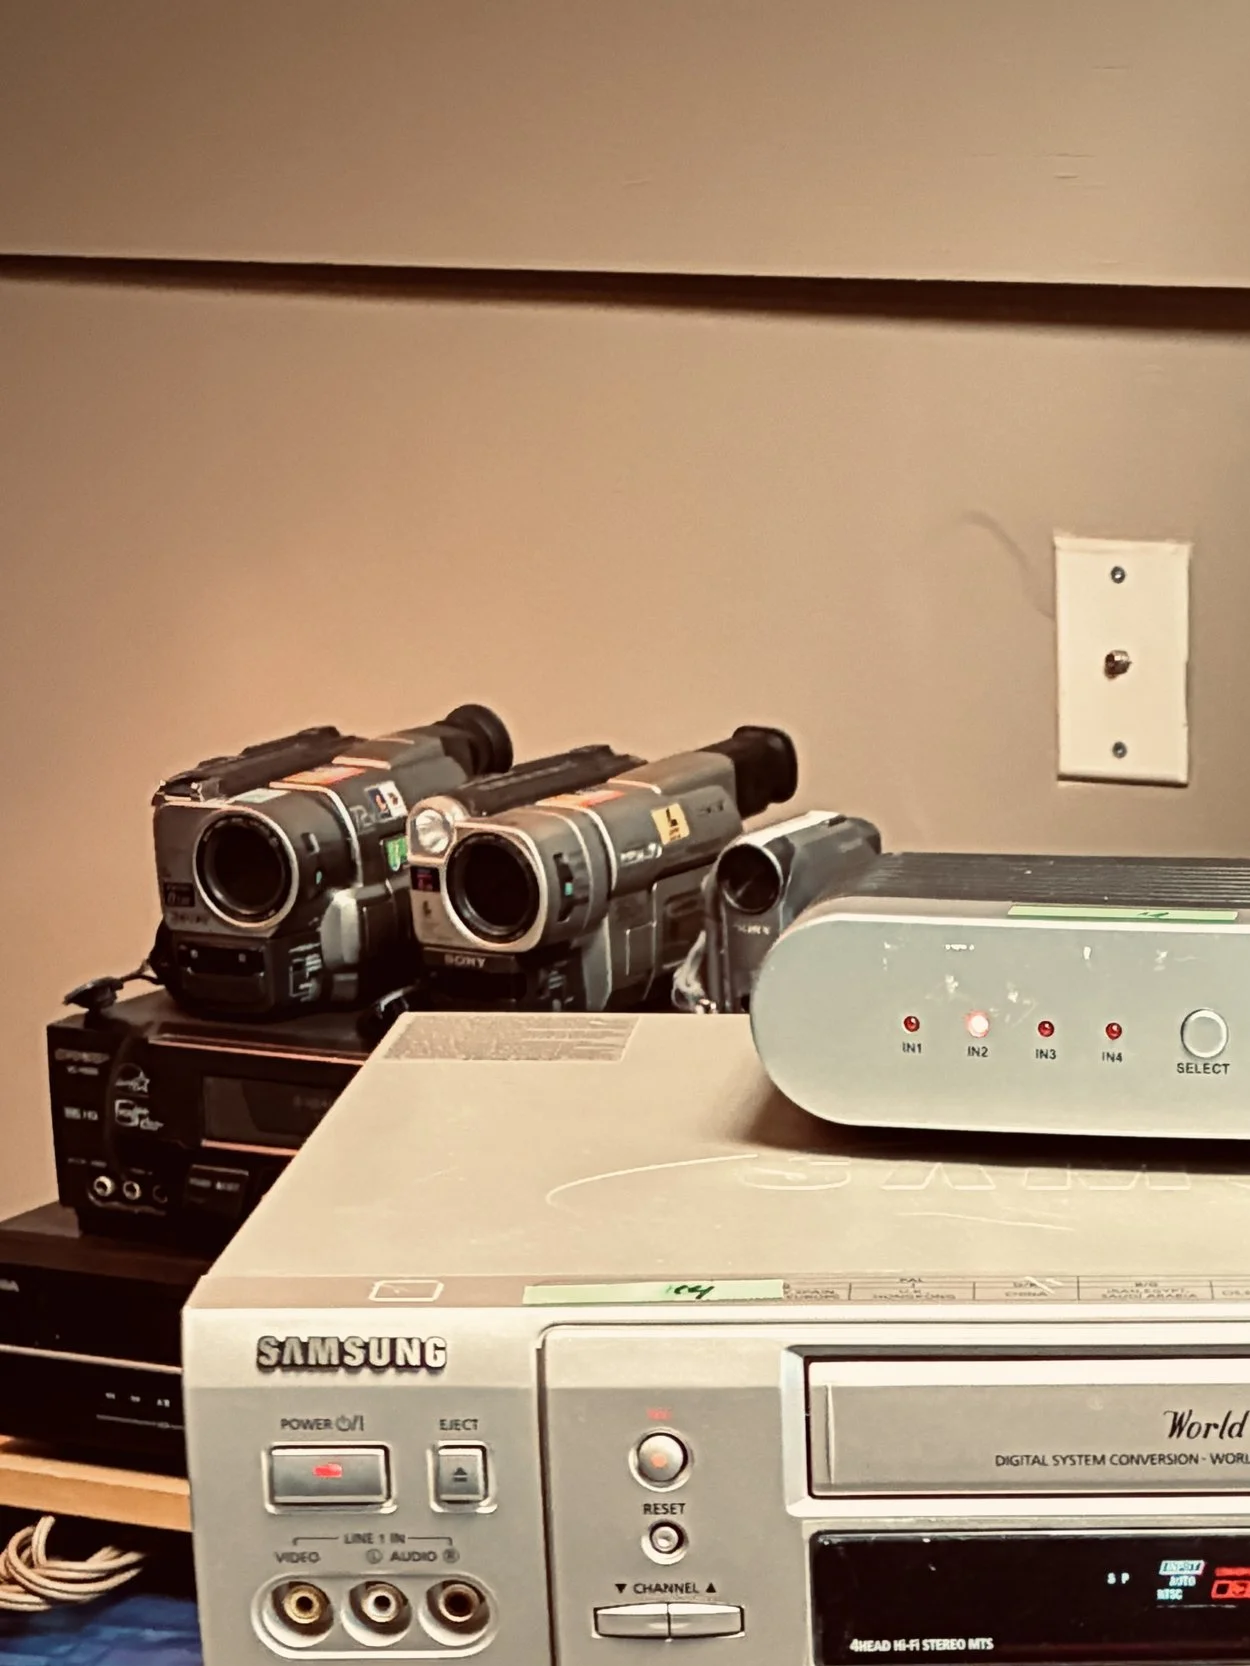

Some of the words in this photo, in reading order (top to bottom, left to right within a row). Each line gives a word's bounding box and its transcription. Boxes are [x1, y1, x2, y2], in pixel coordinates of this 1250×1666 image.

[902, 1042, 922, 1055] IN1
[967, 1045, 988, 1057] IN2
[1035, 1048, 1057, 1060] IN3
[1101, 1051, 1123, 1064] IN4
[1176, 1061, 1230, 1075] SELECT
[256, 1335, 448, 1374] SAMSUNG
[280, 1418, 333, 1432] POWER
[439, 1417, 479, 1431] EJECT
[1163, 1409, 1250, 1440] World
[995, 1454, 1049, 1468] DIGITAL
[1052, 1454, 1106, 1467] SYSTEM
[1110, 1452, 1199, 1467] CONVERSION
[643, 1502, 685, 1516] RESET
[275, 1551, 321, 1564] VIDEO
[633, 1582, 699, 1595] CHANNEL
[850, 1638, 891, 1652] 4HEAD
[922, 1638, 967, 1651] STEREO
[968, 1637, 994, 1651] MTS
